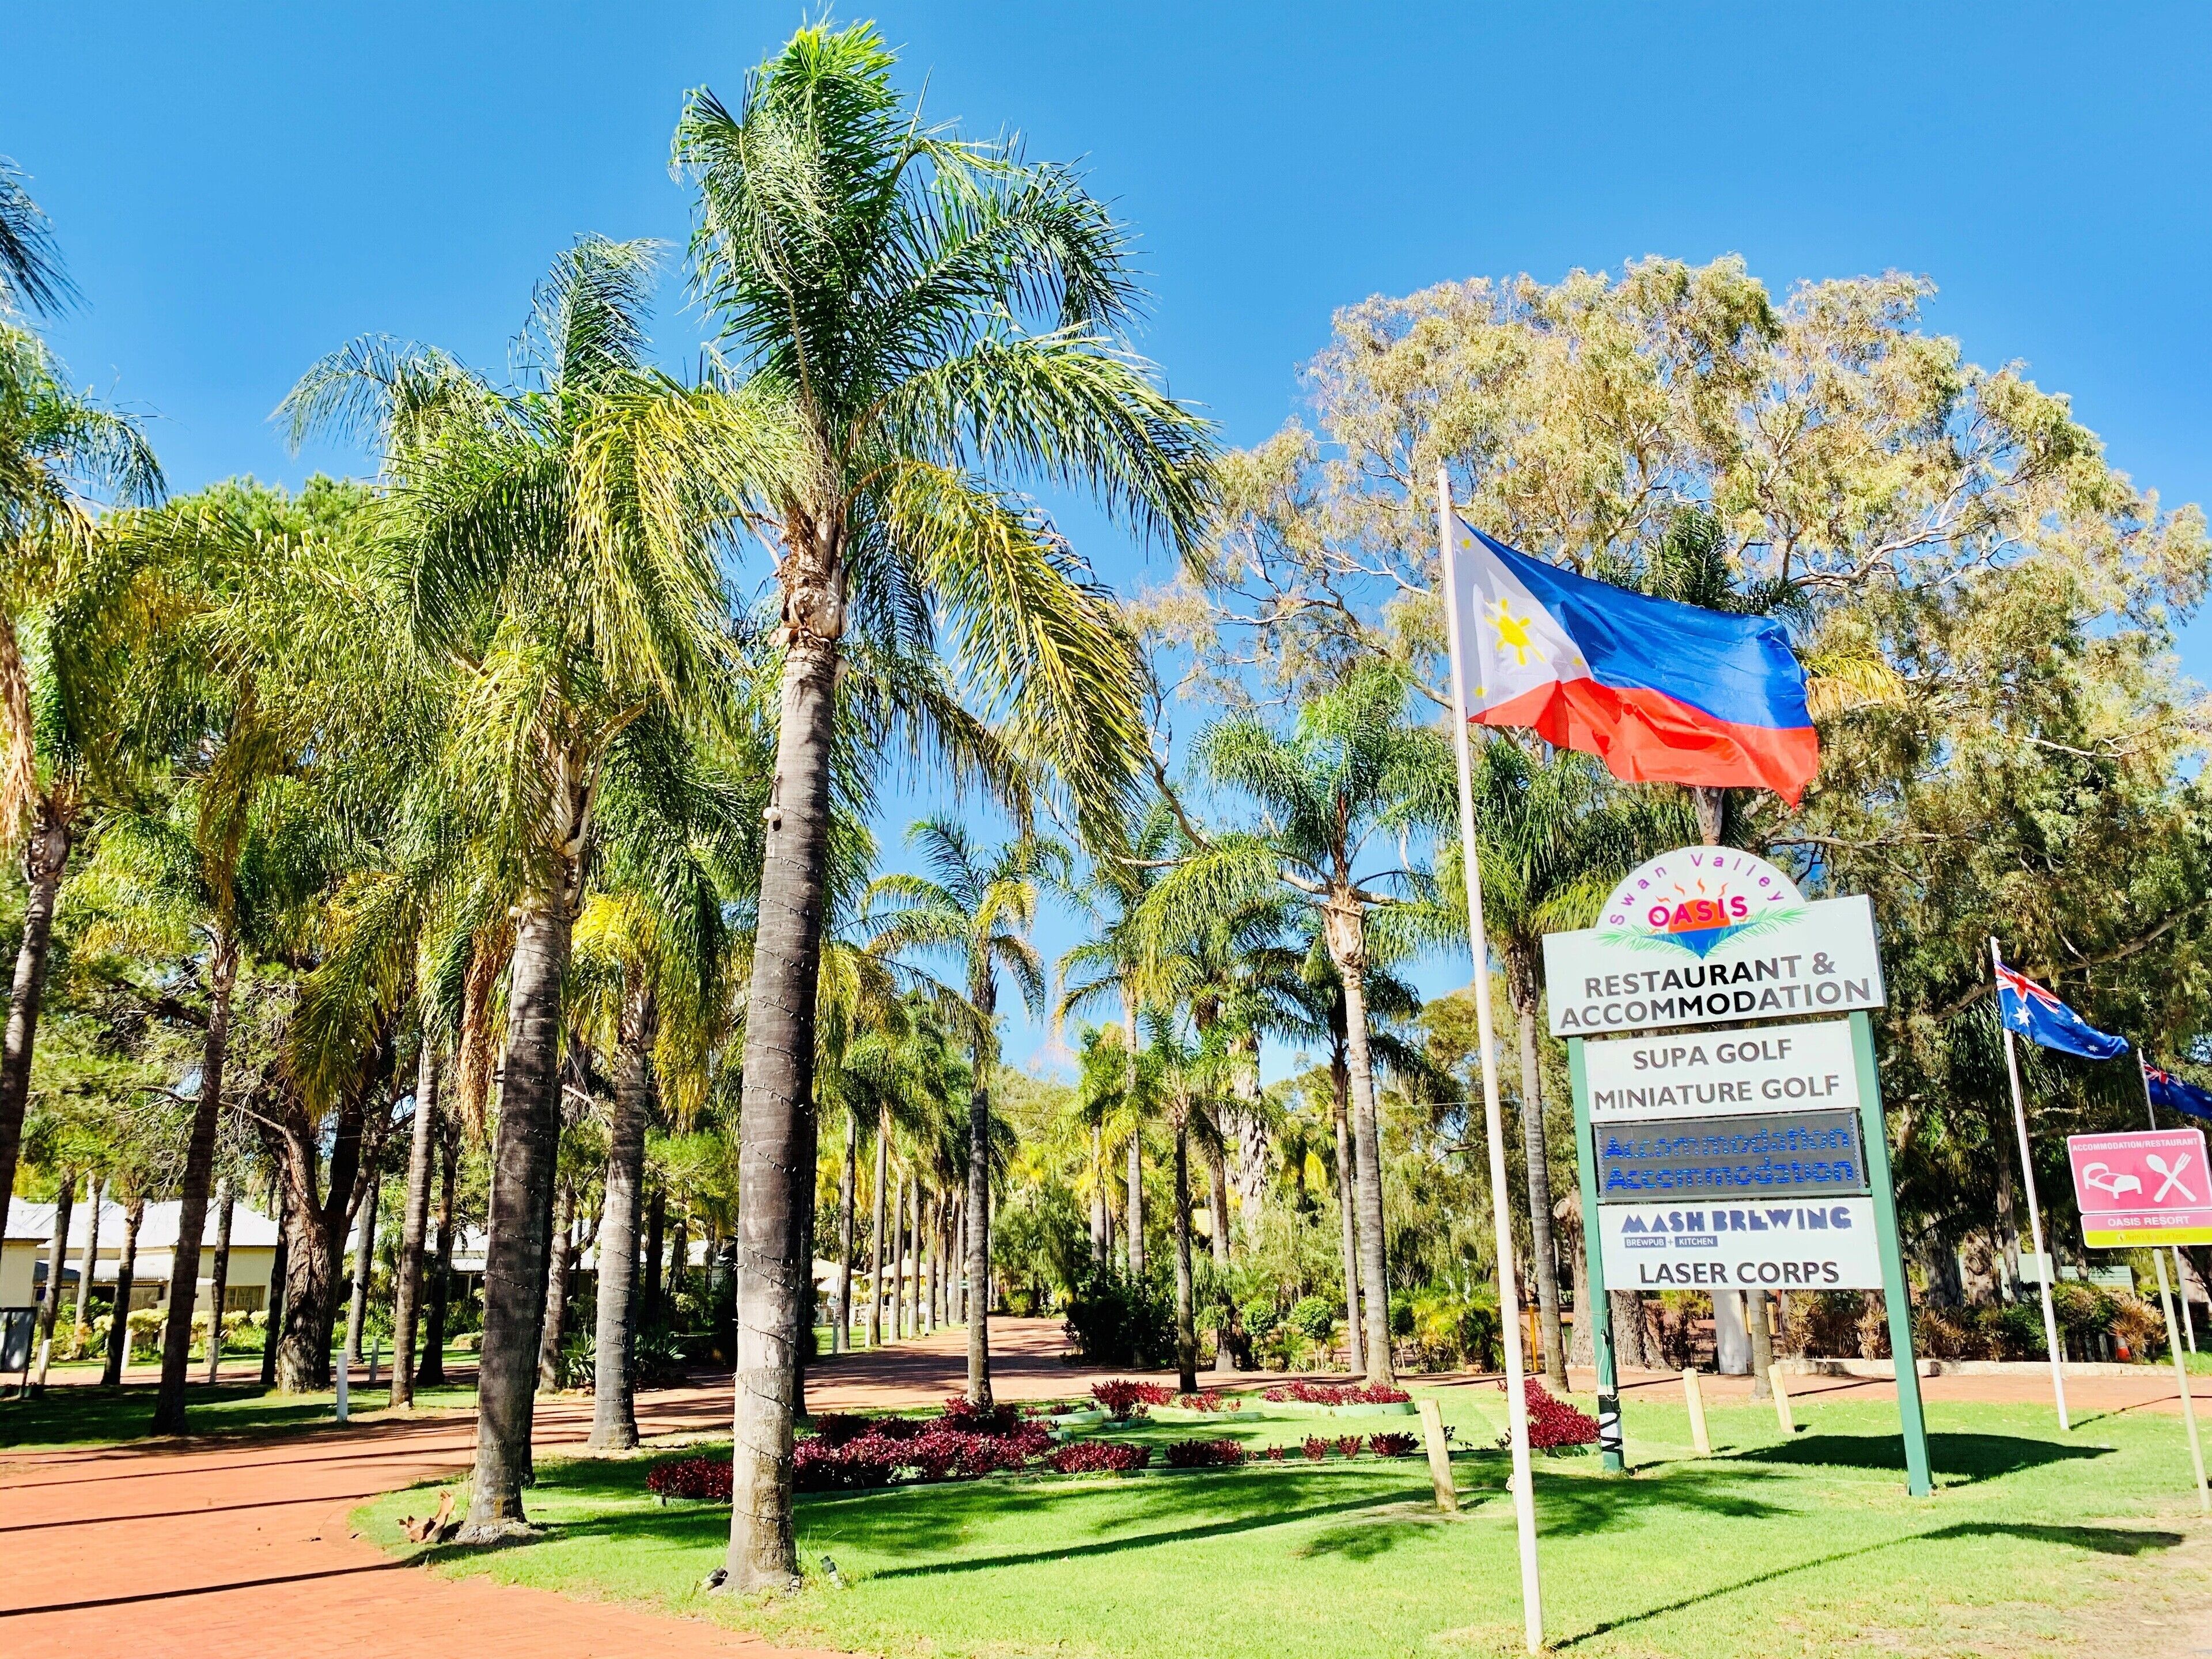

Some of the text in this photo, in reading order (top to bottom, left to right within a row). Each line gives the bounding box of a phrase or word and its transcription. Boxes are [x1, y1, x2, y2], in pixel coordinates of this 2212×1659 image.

[1609, 853, 1785, 925] Swan Valley
[1649, 896, 1748, 927] OASIS
[1585, 952, 1836, 998] RESTAURANT &
[1560, 979, 1870, 1029] ACCOMMODATION
[1633, 1039, 1793, 1070] SUPA GOLF
[1594, 1075, 1840, 1109] MINIATURE GOLF
[1604, 1127, 1849, 1158] Accommodation
[2073, 1138, 2198, 1152] ACCOMMODATION/RESTAURANT
[1607, 1157, 1854, 1190] Accommodation
[1620, 1206, 1852, 1233] MASH BREWING
[2108, 1216, 2190, 1226] OASIS RESORT
[1626, 1238, 1664, 1247] BREWPUB
[1679, 1237, 1714, 1246] KITCHEN
[1639, 1262, 1840, 1285] LASER CORPS
